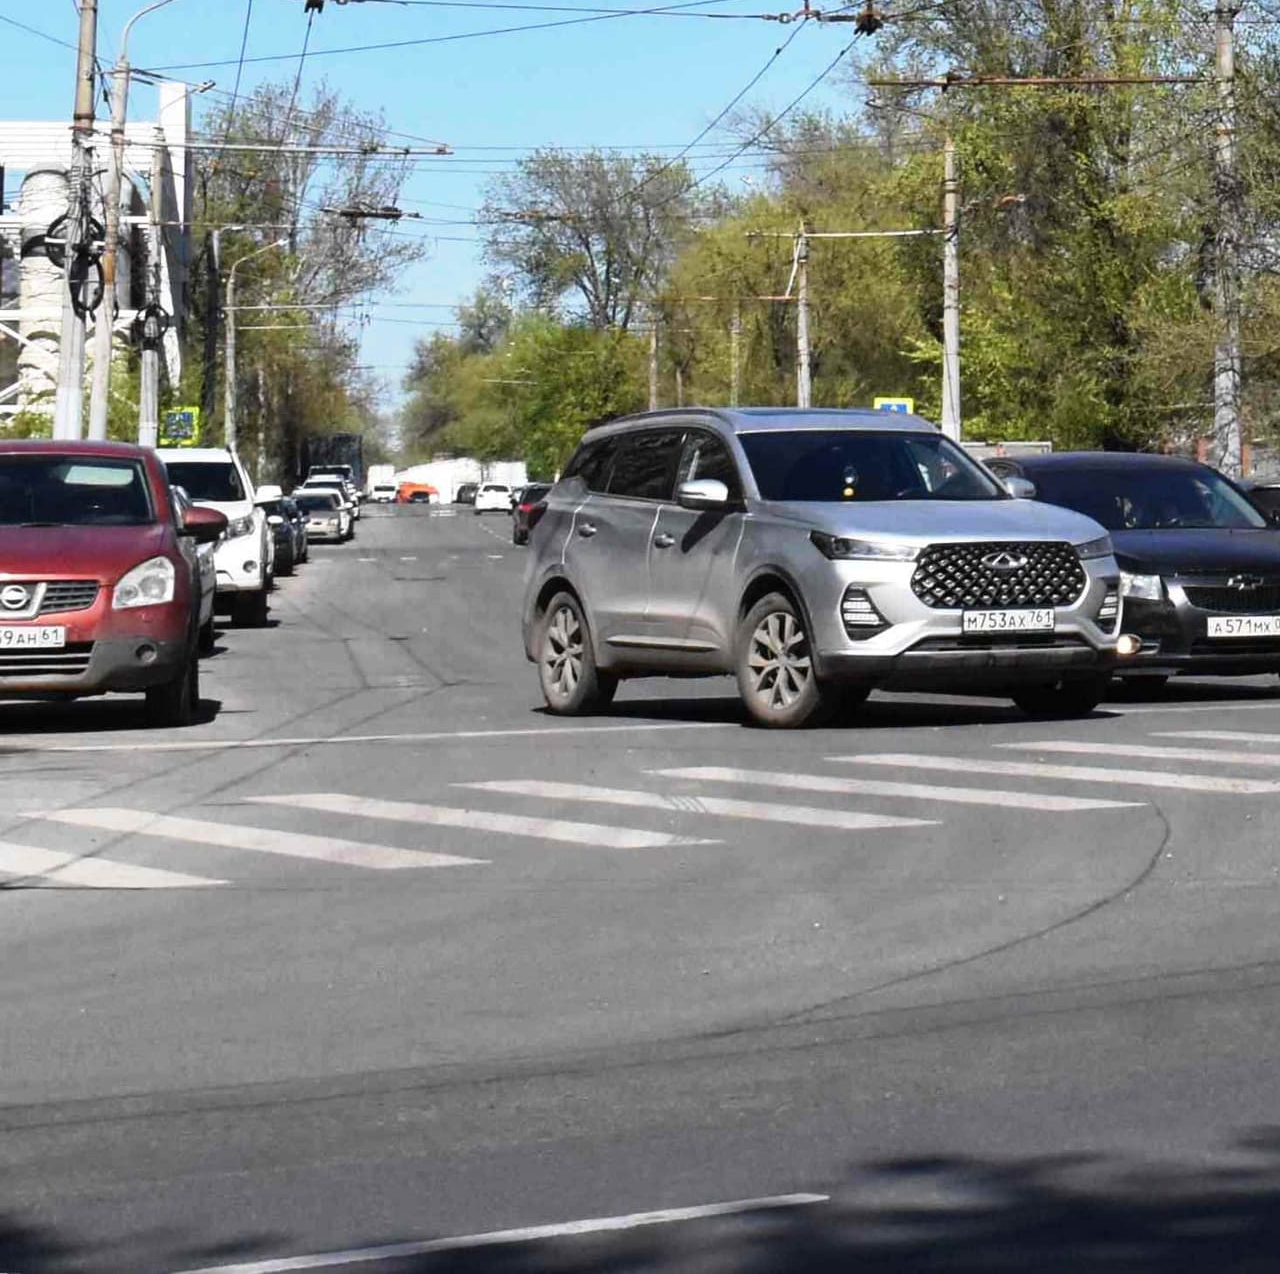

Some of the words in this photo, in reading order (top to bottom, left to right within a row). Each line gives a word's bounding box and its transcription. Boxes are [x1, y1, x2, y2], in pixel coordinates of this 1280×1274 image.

[967, 611, 1026, 629] М753АХ
[1030, 610, 1051, 624] 761
[1214, 618, 1271, 634] А571МХ
[0, 630, 37, 645] 9АН
[42, 628, 59, 641] 61
